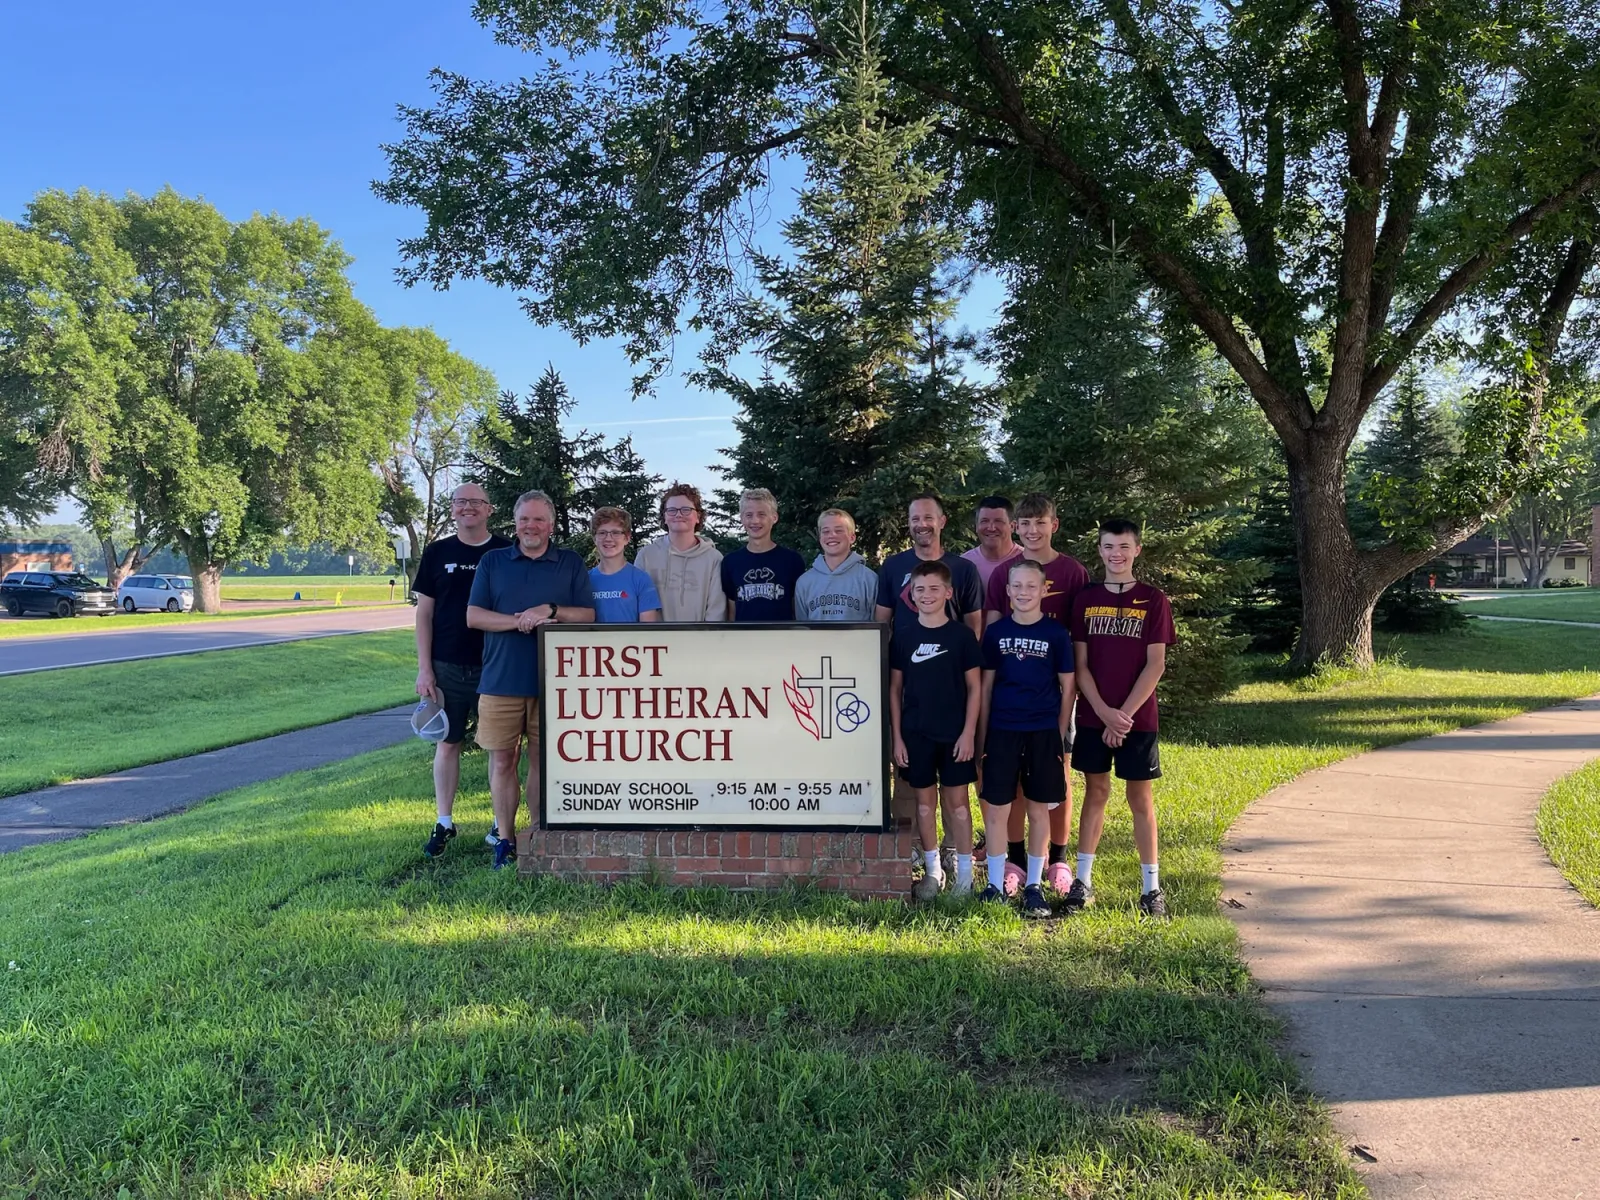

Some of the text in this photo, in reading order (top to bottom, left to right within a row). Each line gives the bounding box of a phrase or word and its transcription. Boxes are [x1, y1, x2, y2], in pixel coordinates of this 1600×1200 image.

[592, 591, 622, 599] ENEROUSLY
[917, 643, 941, 655] NIKE
[1014, 638, 1049, 652] PETER
[555, 646, 668, 677] FIRST
[556, 687, 771, 720] LUTHERAN
[556, 729, 733, 762] CHURCH
[562, 782, 621, 796] SUNDAY
[628, 782, 694, 796] SCHOOL
[716, 782, 747, 796] 9:15
[753, 782, 777, 796] AM
[798, 782, 833, 796] 9:55
[839, 782, 862, 796] AM
[562, 798, 820, 811] SUNDAY WORSHIP 10:00 AM
